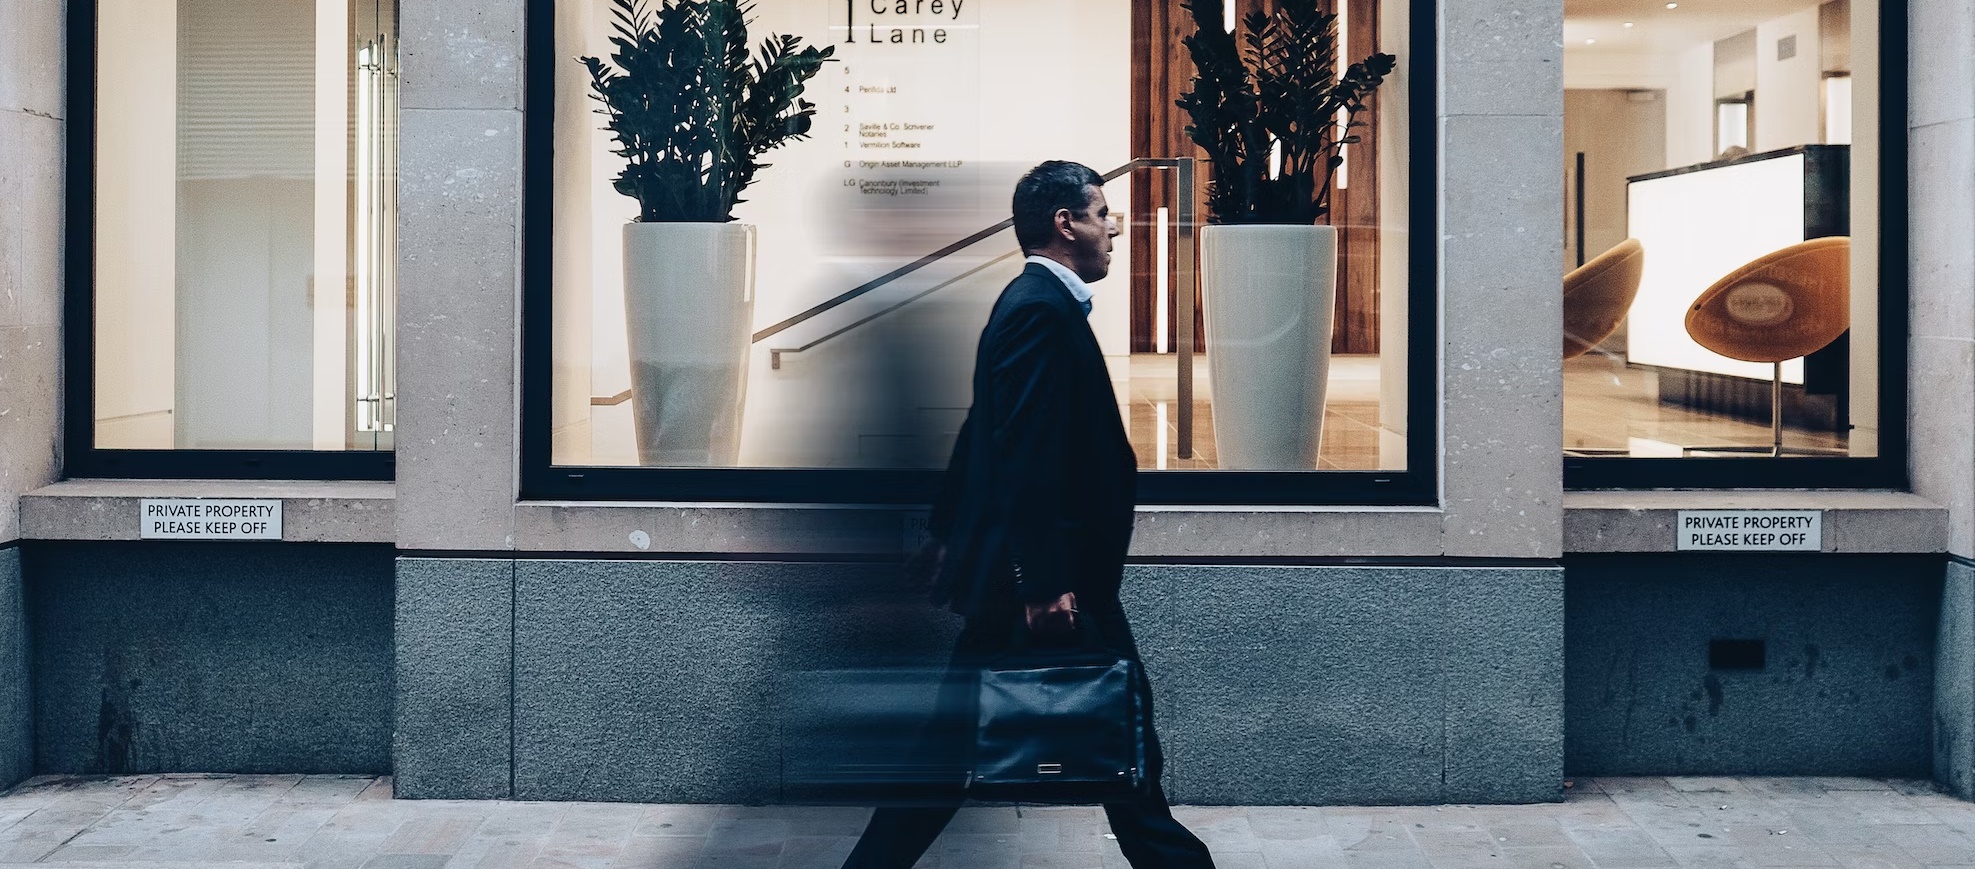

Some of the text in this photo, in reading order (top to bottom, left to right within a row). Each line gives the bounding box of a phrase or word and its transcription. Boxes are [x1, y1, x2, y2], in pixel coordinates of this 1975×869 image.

[871, 0, 963, 20] Carey
[870, 23, 947, 43] Lane
[844, 66, 850, 74] 5
[844, 85, 850, 93] 4
[844, 105, 849, 113] 3
[844, 124, 850, 132] 2
[903, 123, 935, 131] Scrivener
[844, 160, 963, 169] G Origin Asset Management LLP
[843, 179, 856, 187] LG
[859, 187, 899, 196] Technology
[148, 505, 274, 518] PRIVATE PROPERTY
[1685, 516, 1813, 529] PRIVATE PROPERTY
[154, 521, 267, 534] PLEASE KEEP OFF
[1691, 533, 1807, 546] PLEASE KEEP OFF
